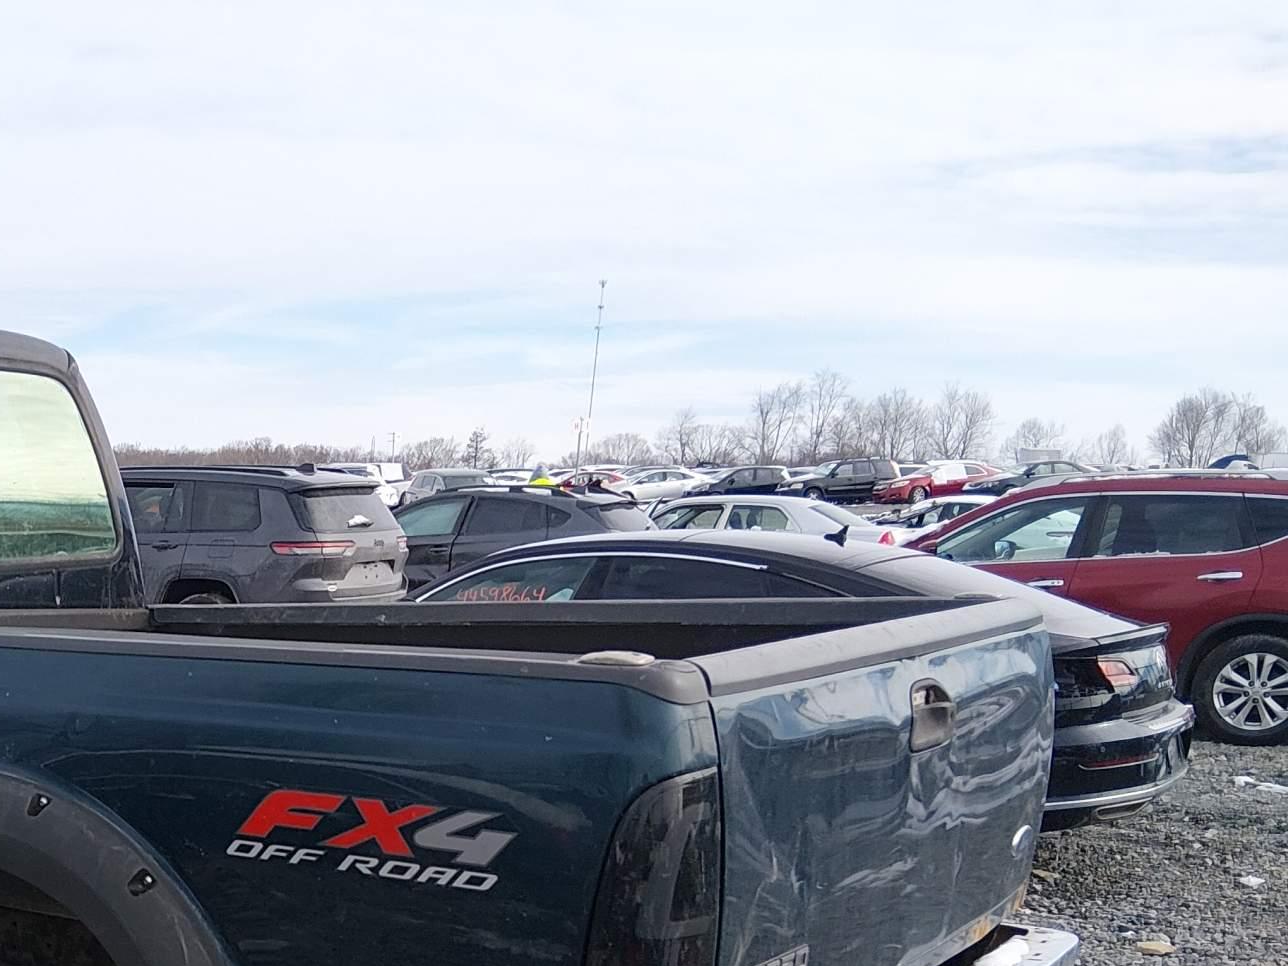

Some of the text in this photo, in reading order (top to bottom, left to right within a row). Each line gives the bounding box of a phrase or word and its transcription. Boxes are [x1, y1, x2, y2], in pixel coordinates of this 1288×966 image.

[237, 789, 518, 867] FX4
[226, 839, 498, 891] OFF ROAD
